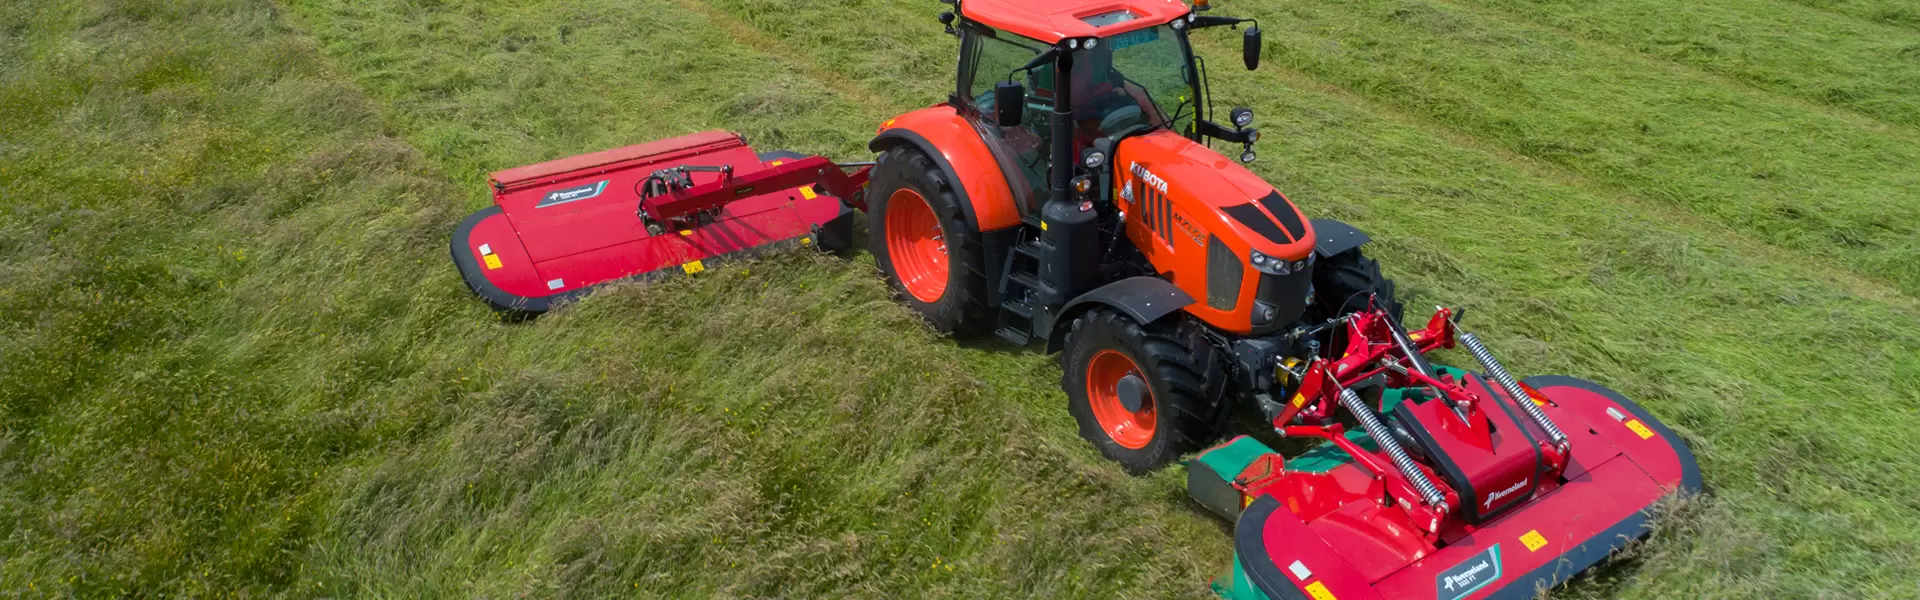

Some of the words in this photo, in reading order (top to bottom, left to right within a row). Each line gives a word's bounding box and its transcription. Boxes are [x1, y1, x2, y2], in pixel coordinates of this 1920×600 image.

[1129, 161, 1168, 195] KUBOTA
[1494, 477, 1528, 500] Kverneland
[1452, 560, 1489, 583] Kverneland
